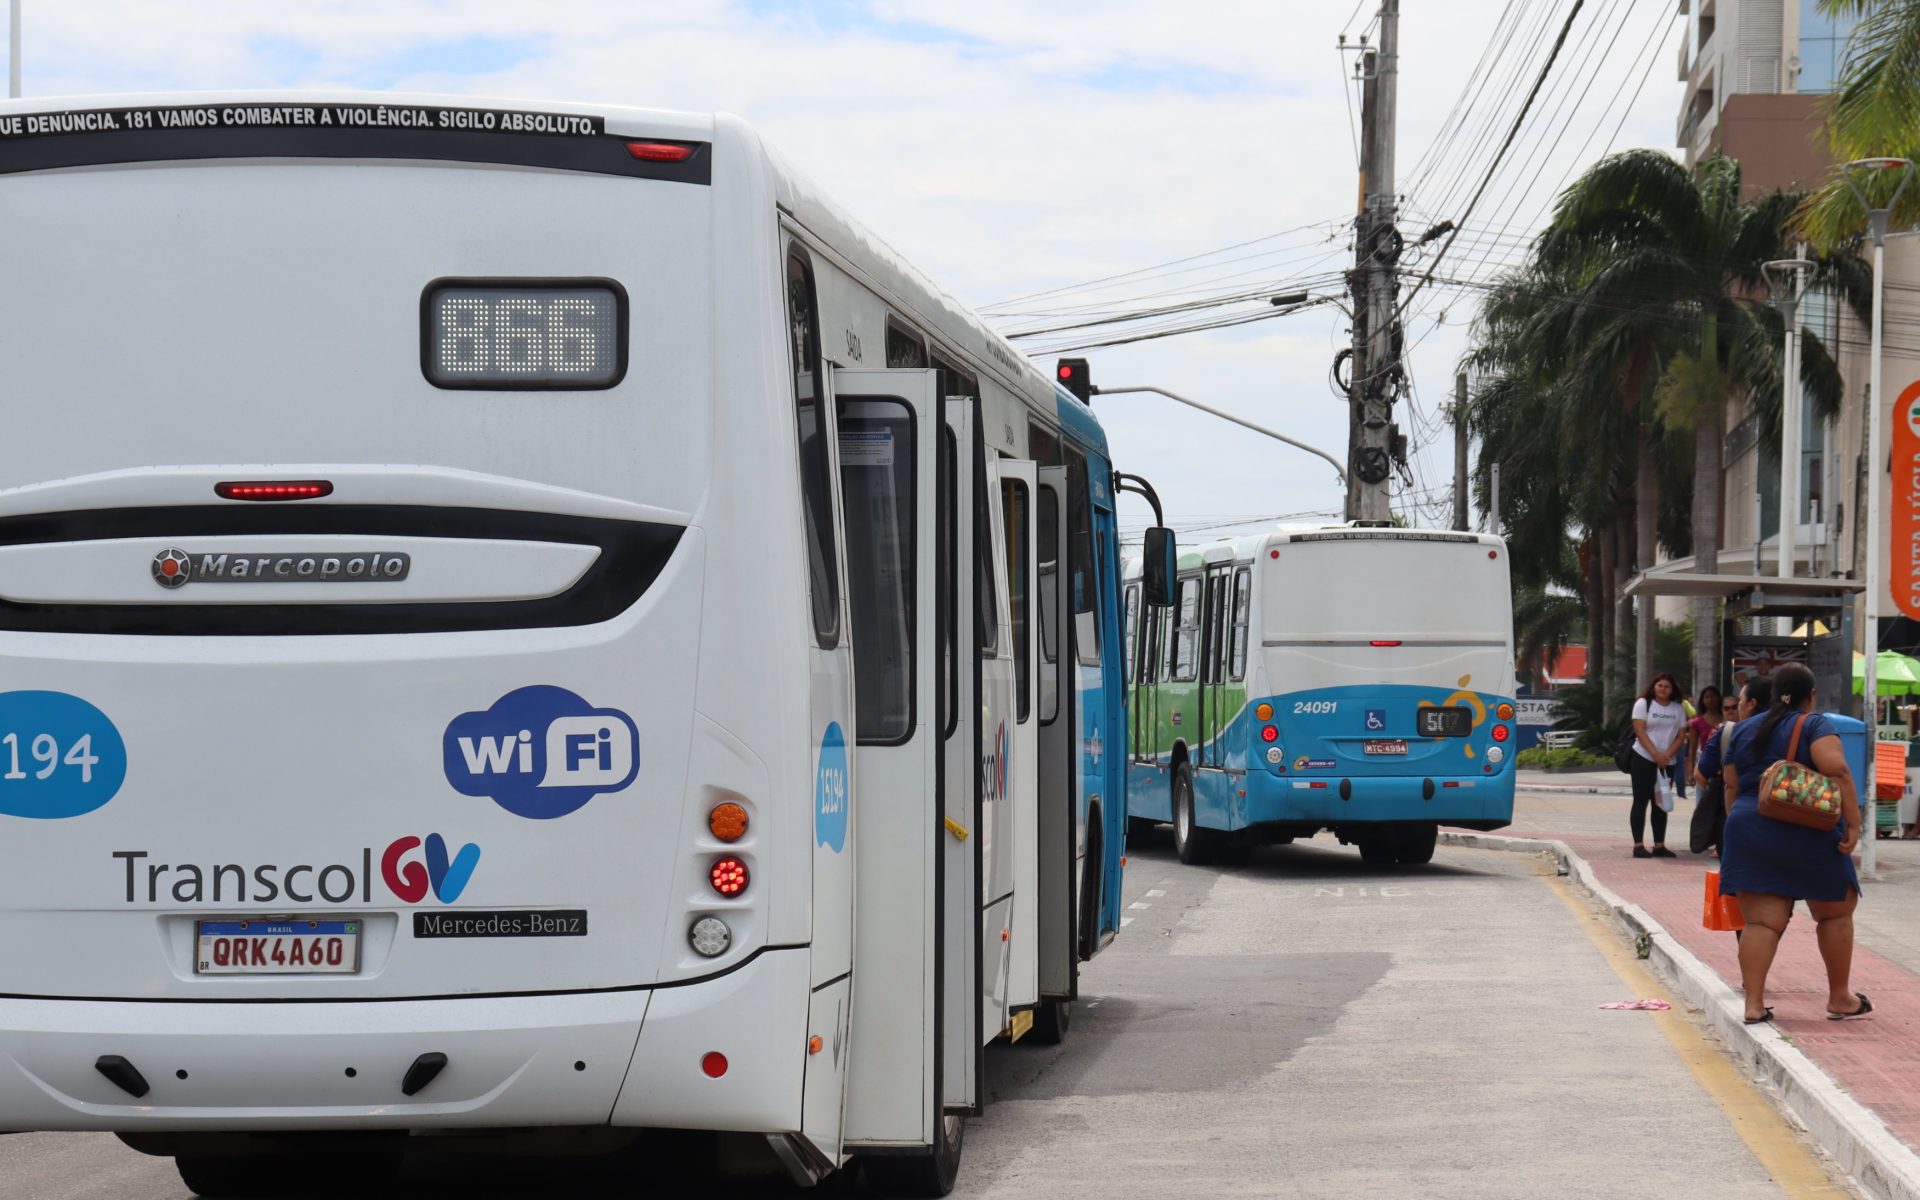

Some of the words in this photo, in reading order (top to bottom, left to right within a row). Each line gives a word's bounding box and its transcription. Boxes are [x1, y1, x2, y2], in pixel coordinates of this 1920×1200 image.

[27, 110, 120, 133] DENÚNCIA.
[124, 110, 153, 128] 181
[157, 109, 218, 127] VAMOS
[222, 107, 316, 125] COMBATER
[320, 107, 333, 125] A
[337, 105, 434, 128] VIOLÊNCIA.
[438, 110, 496, 129] SIGILO
[500, 113, 596, 135] ABSOLUTO.
[441, 299, 595, 372] 866
[199, 553, 404, 580] Marcopolo
[1293, 701, 1337, 714] 24091
[820, 767, 844, 815] 15194
[267, 926, 293, 934] BRASIL
[421, 913, 580, 935] Mercedes-Benz
[200, 961, 209, 970] BR
[213, 937, 343, 967] QRK4A60
